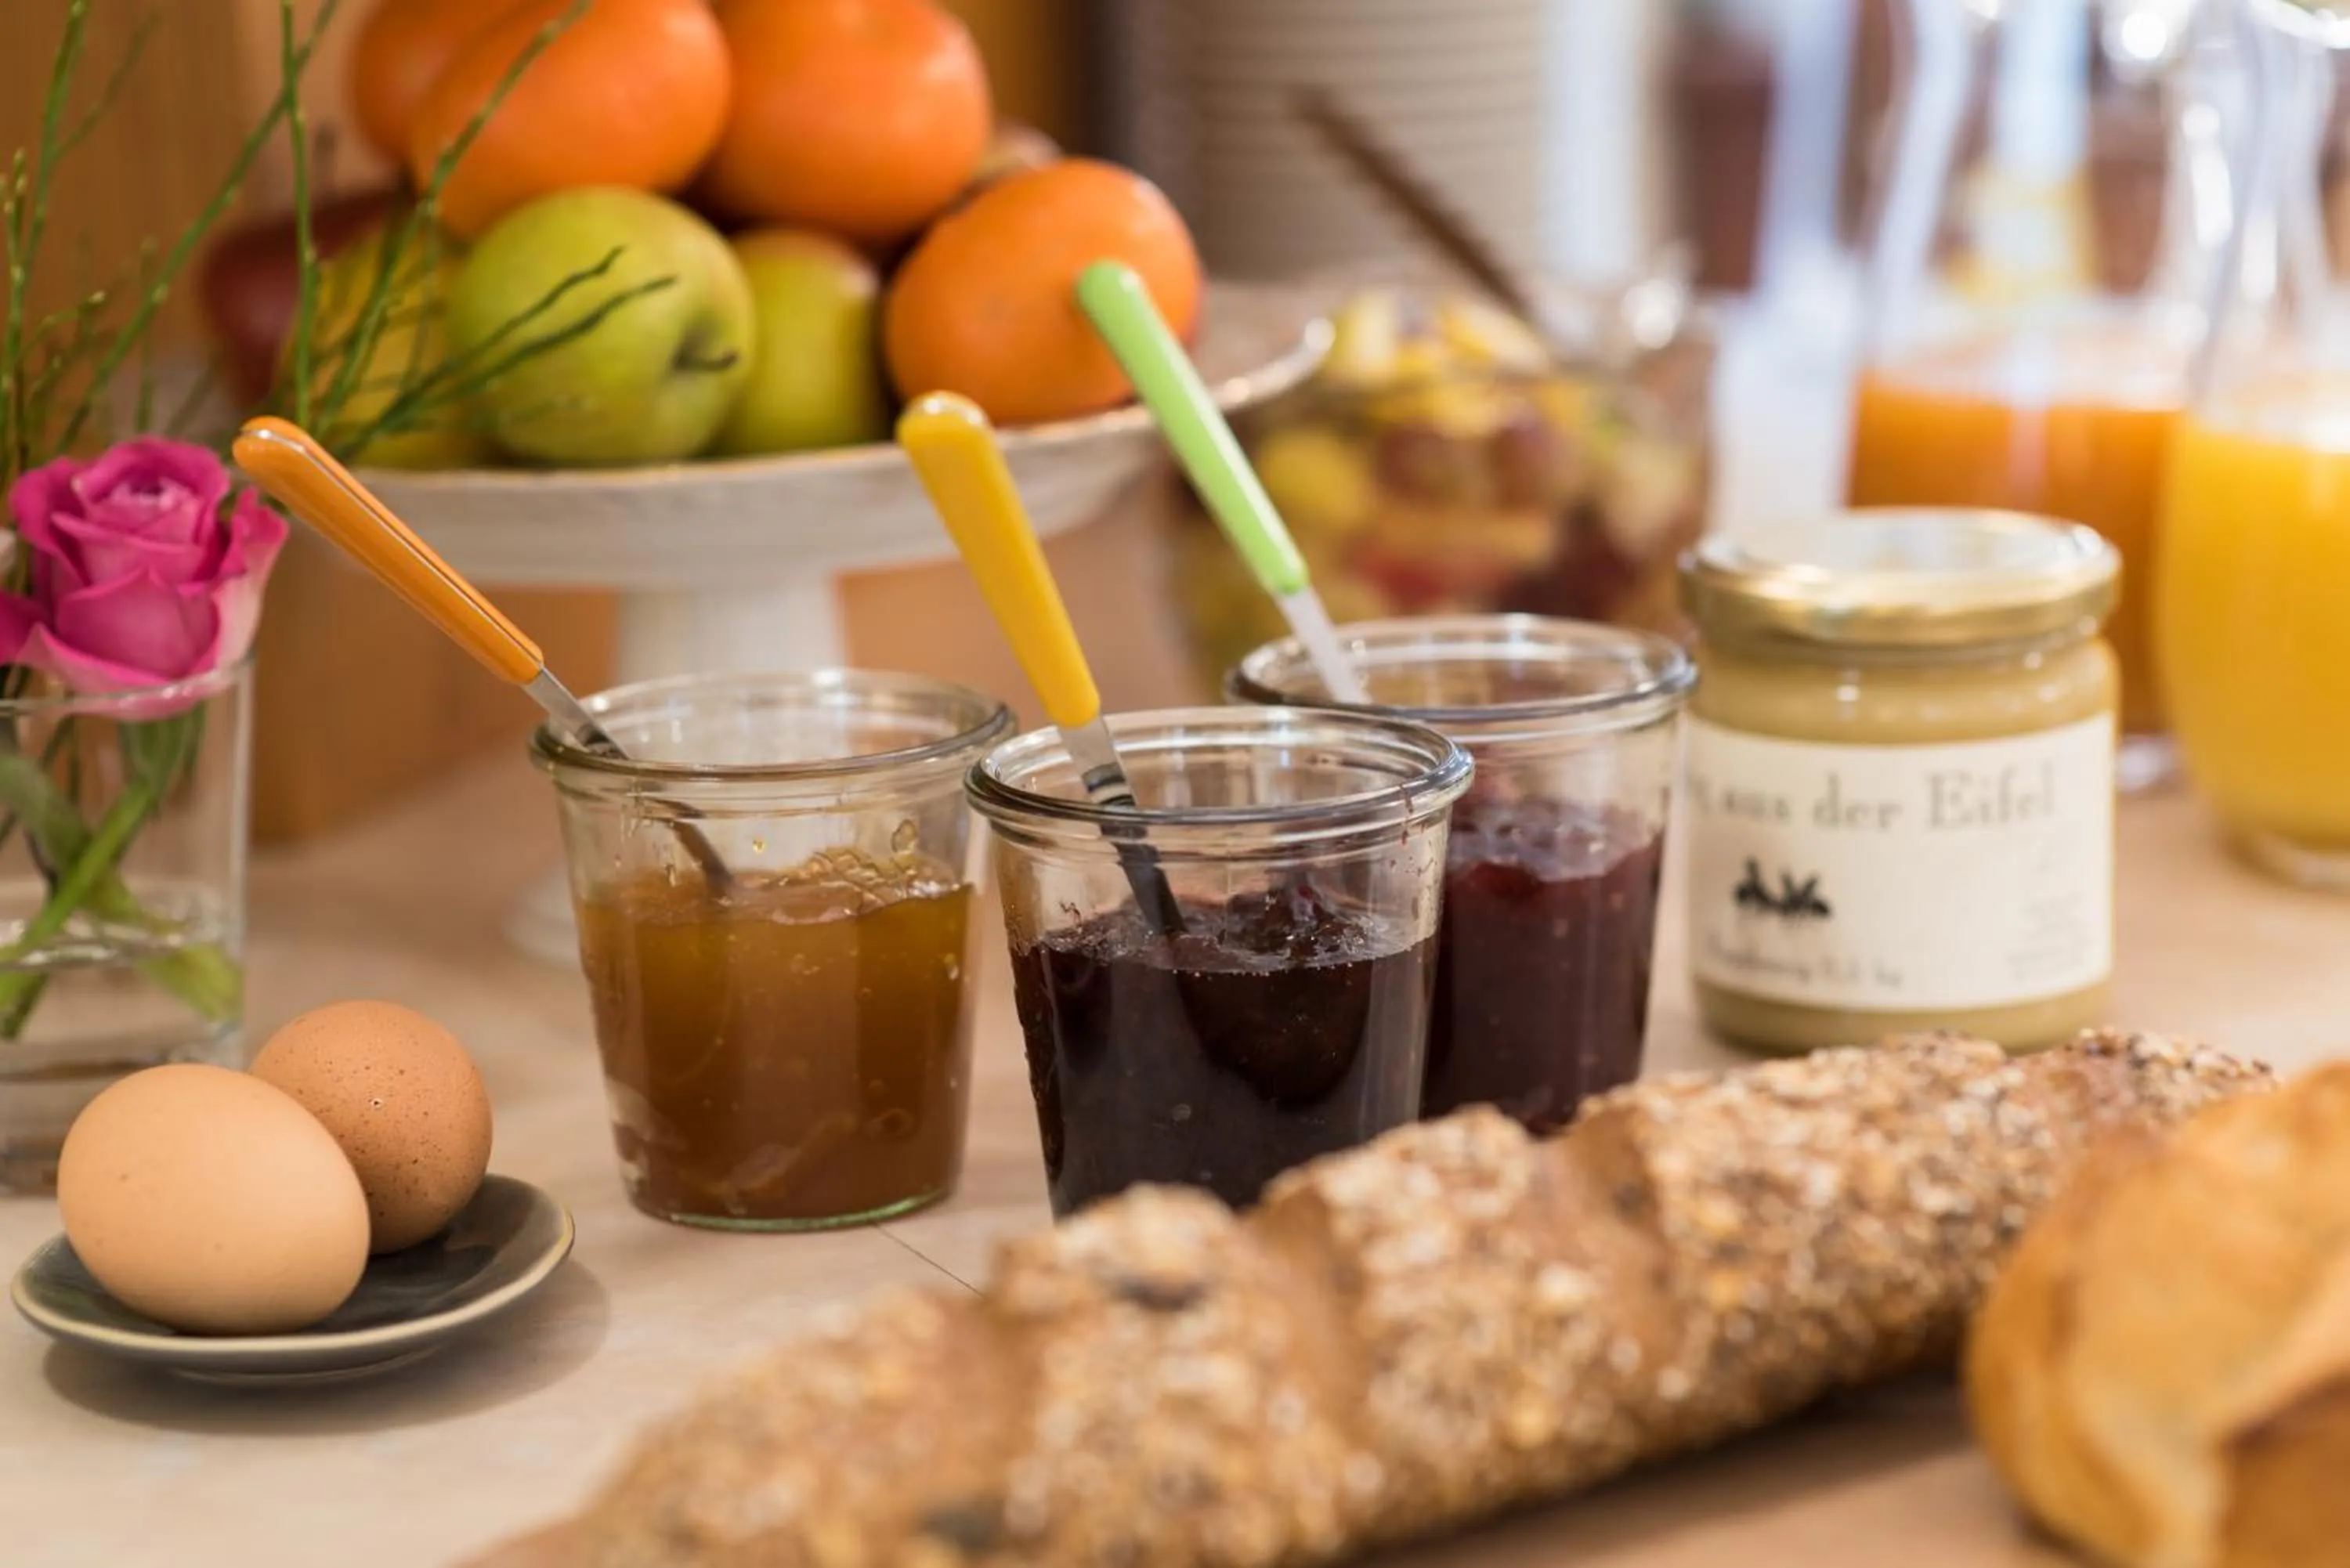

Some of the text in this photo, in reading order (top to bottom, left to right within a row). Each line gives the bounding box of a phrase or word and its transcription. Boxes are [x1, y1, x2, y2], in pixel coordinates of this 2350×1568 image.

[1721, 787, 1791, 826] aus
[1813, 770, 1904, 830] der
[1925, 760, 2056, 832] Eifel
